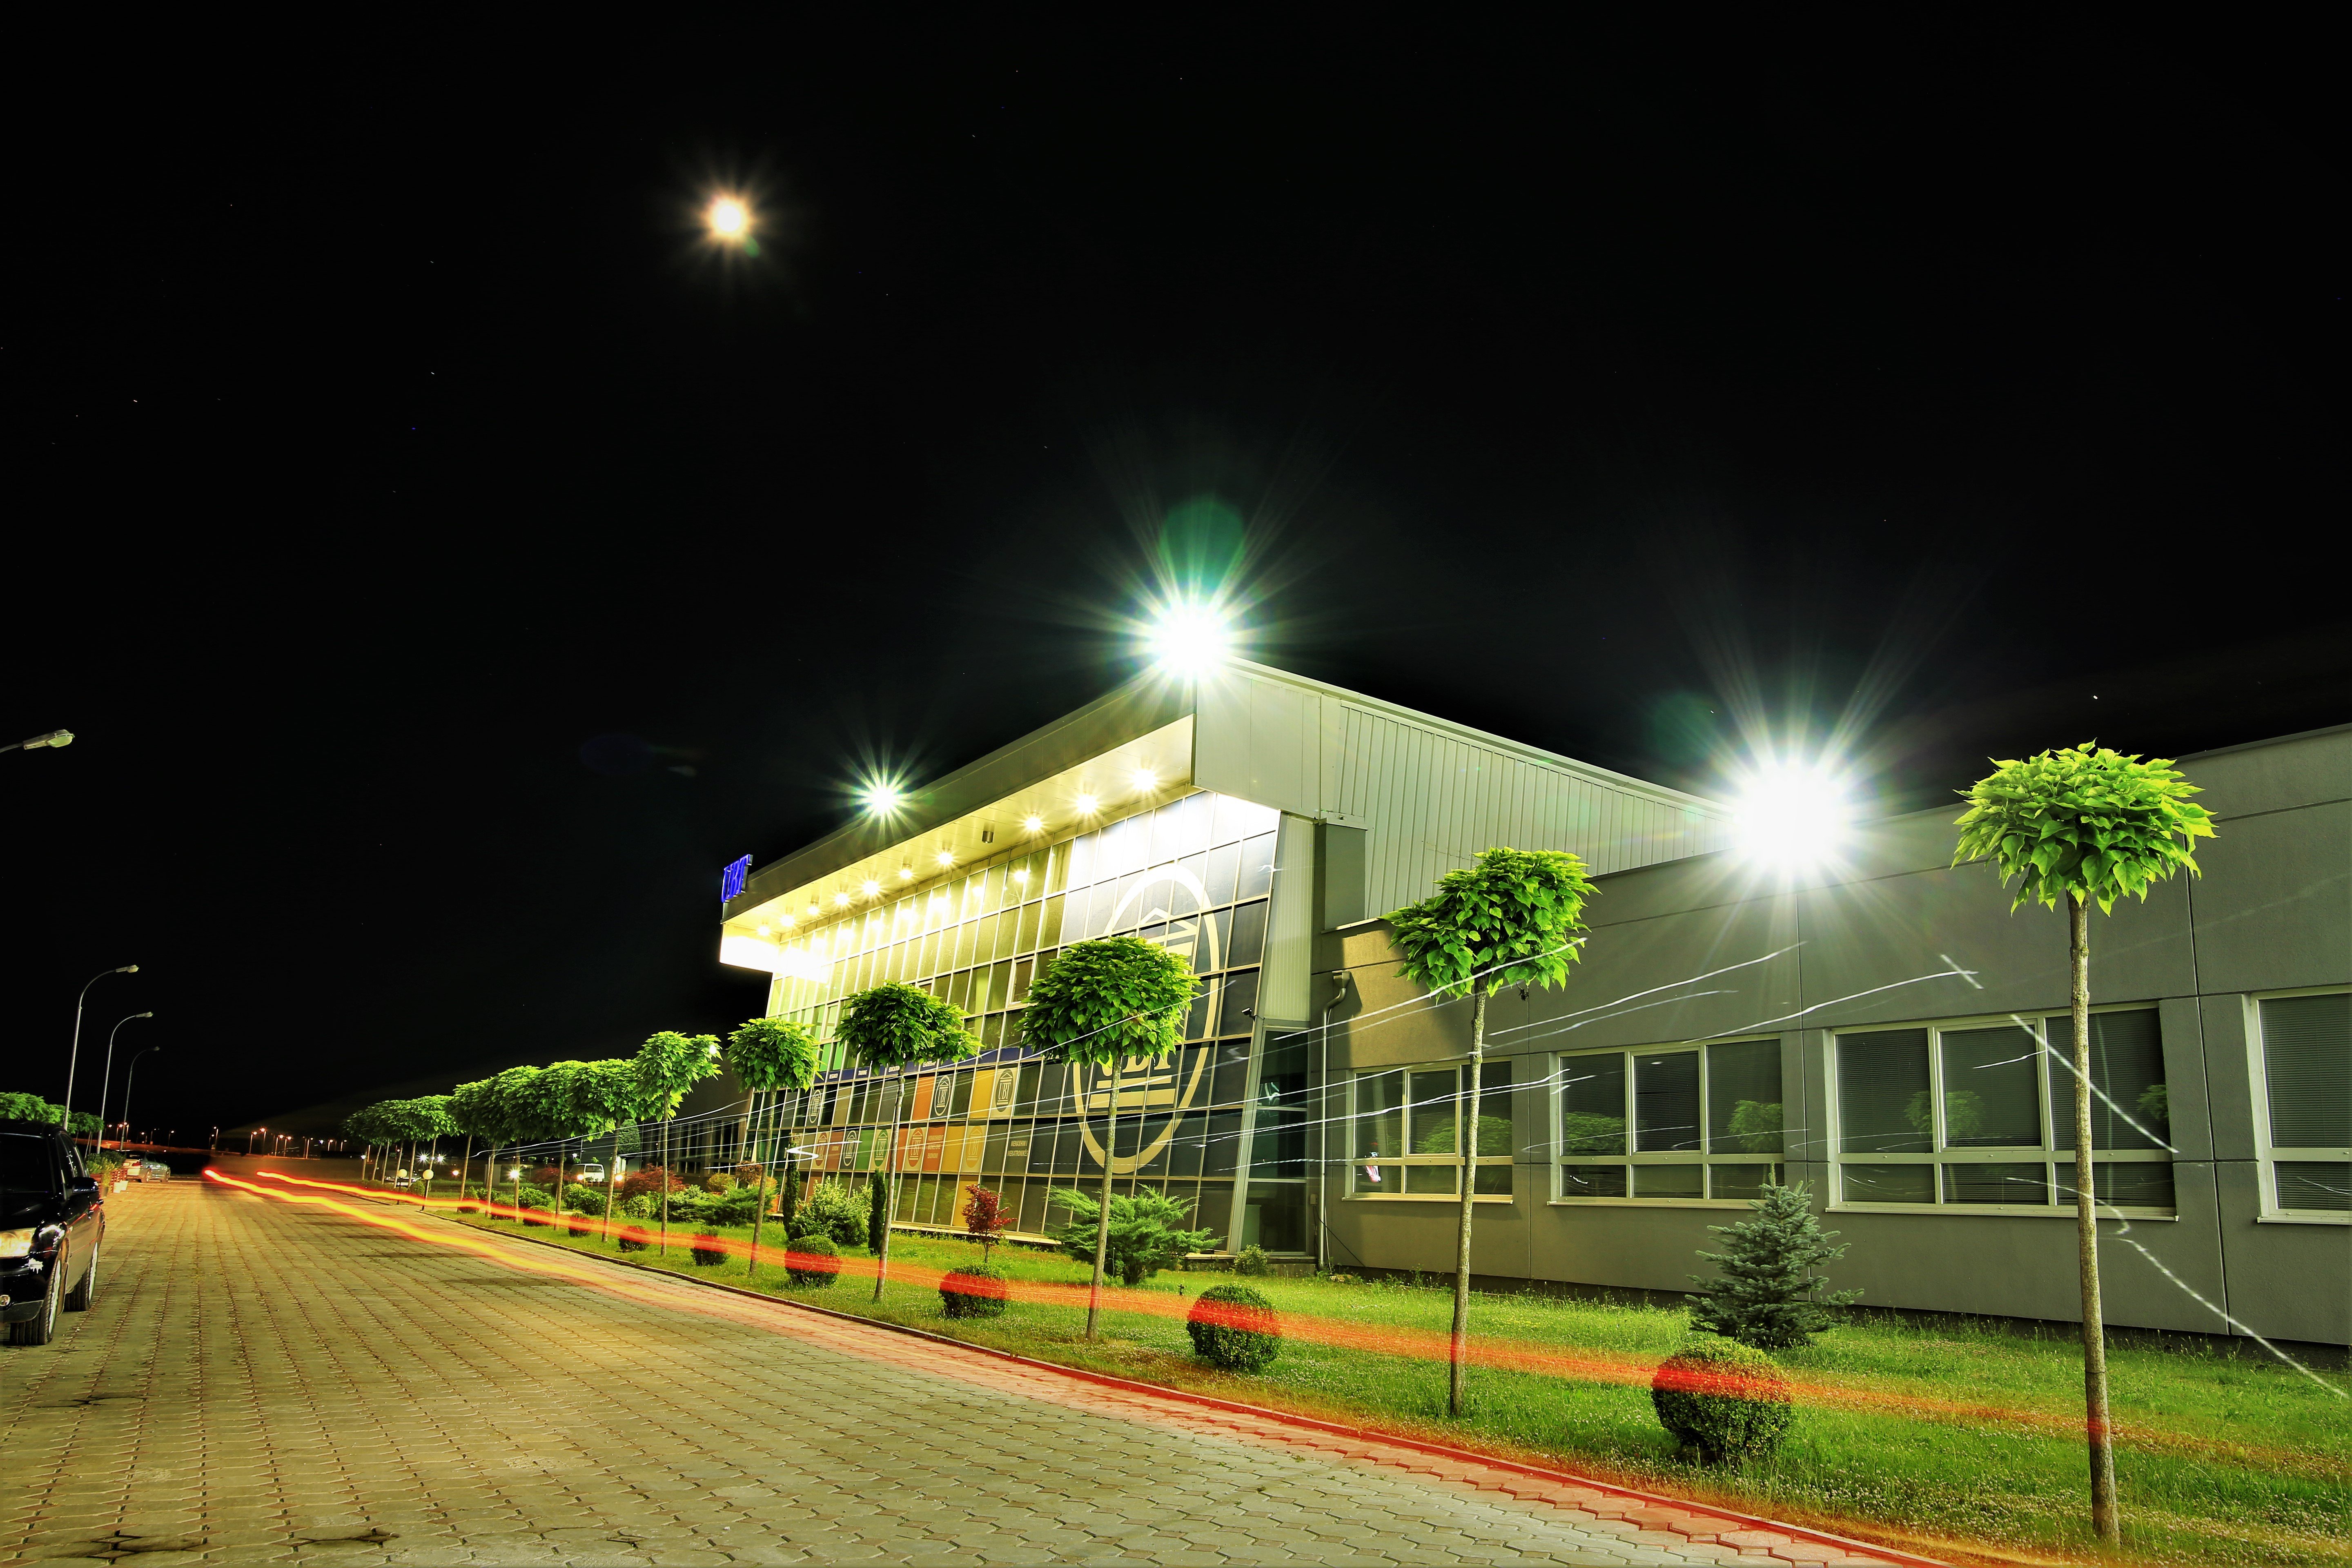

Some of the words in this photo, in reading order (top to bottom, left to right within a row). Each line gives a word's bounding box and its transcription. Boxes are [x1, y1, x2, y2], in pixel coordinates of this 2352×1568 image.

[938, 1089, 948, 1103] UBT
[998, 1082, 1011, 1100] UBT
[876, 1141, 886, 1156] UBT
[911, 1140, 921, 1156] UBT
[969, 1139, 981, 1155] UBT
